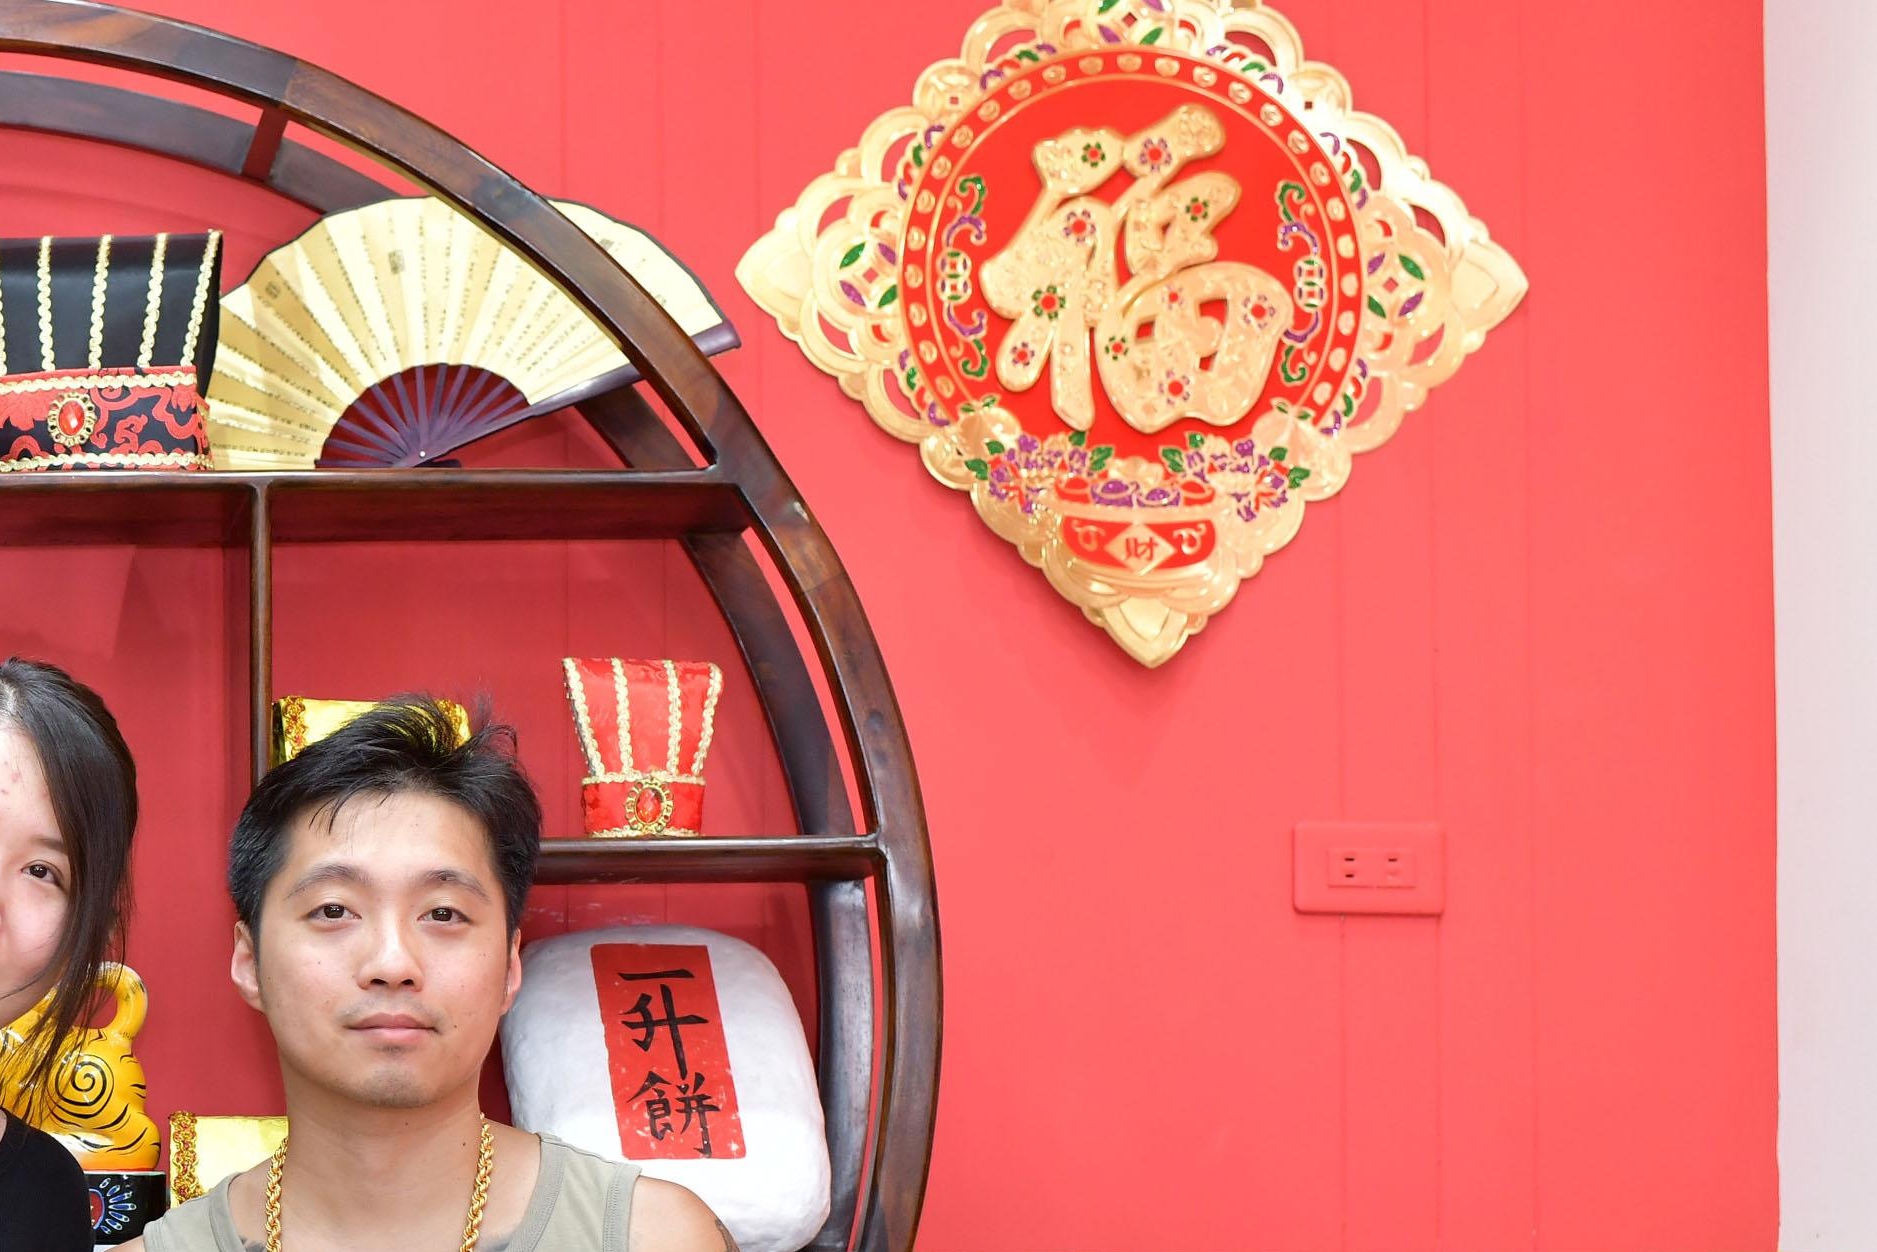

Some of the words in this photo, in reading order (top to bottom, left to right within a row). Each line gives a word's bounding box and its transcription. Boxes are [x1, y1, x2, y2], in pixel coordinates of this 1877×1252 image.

[980, 103, 1292, 434] 福
[617, 967, 721, 1159] 一升餅
